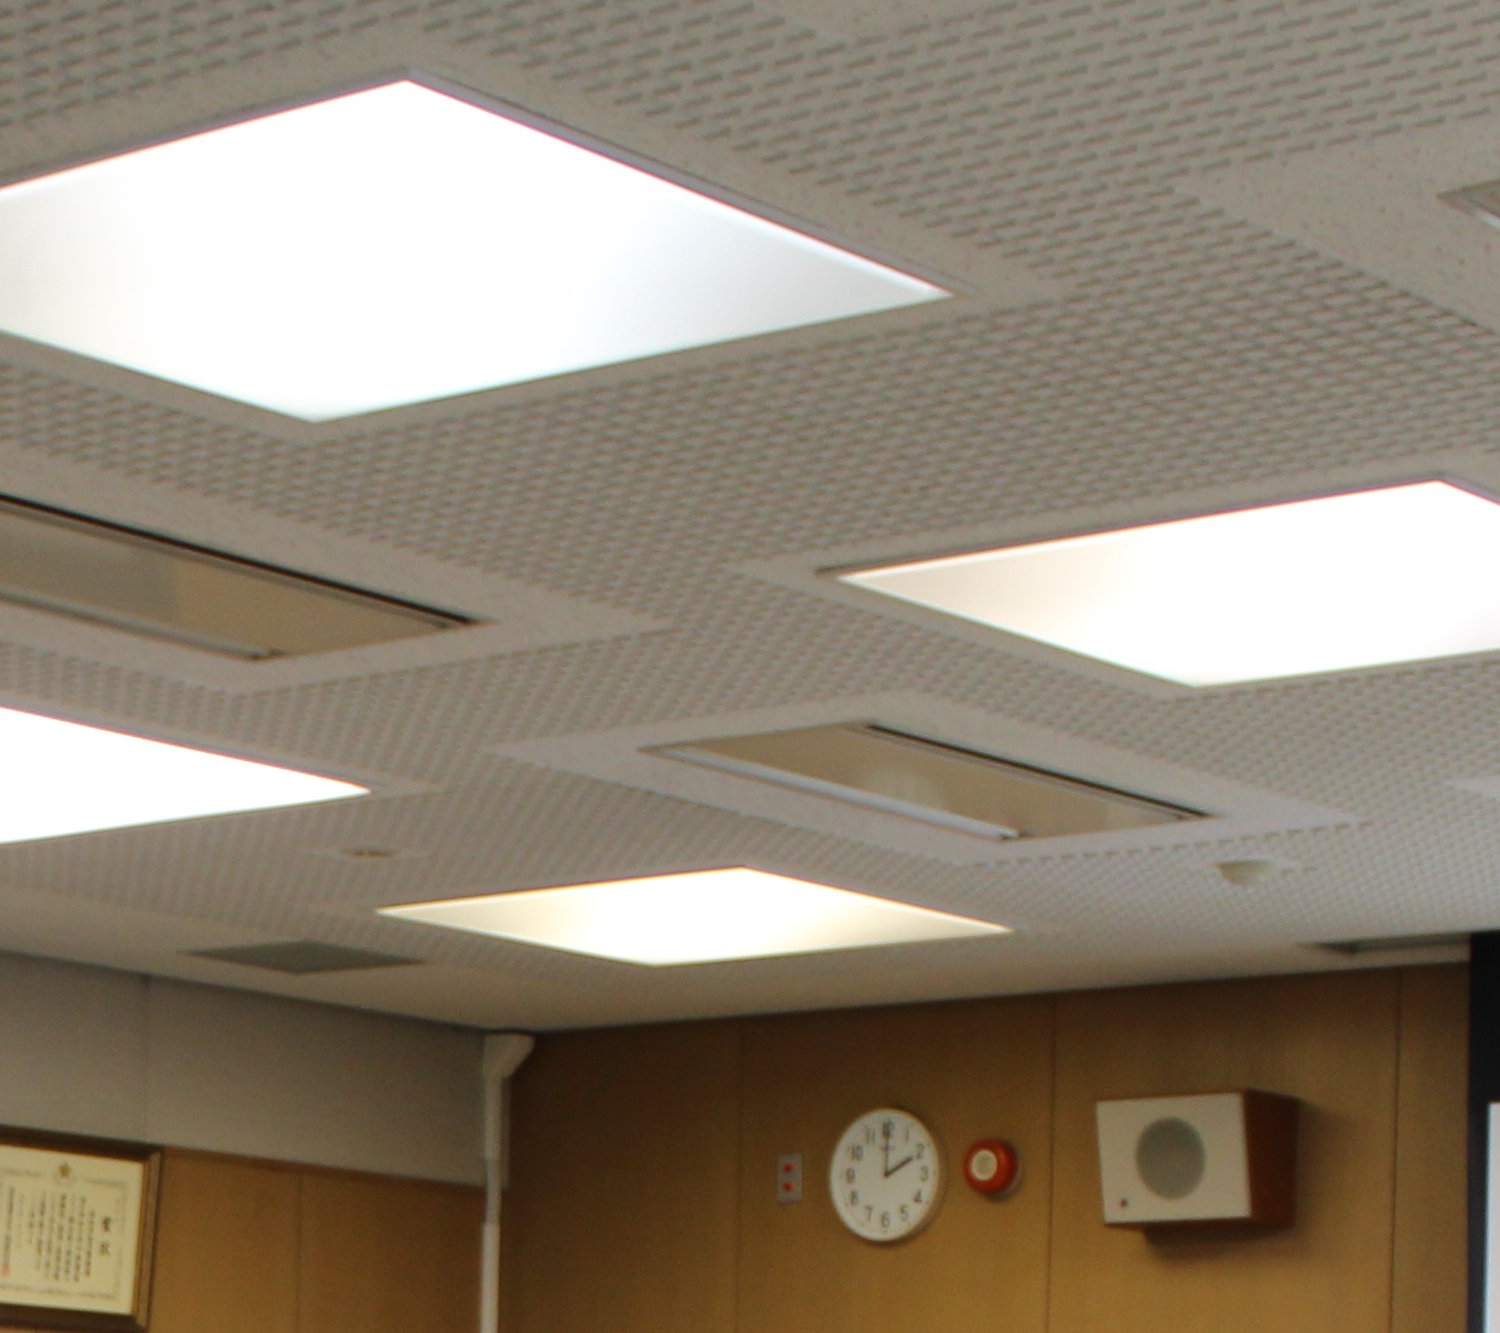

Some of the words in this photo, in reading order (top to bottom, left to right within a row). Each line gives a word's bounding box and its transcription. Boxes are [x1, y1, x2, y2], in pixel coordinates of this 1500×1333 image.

[850, 1144, 864, 1161] 10
[915, 1142, 925, 1160] 2
[845, 1167, 856, 1184] 9
[920, 1165, 929, 1182] 3
[850, 1190, 858, 1206] 8
[913, 1189, 922, 1204] 4
[864, 1205, 873, 1222] 7
[881, 1211, 890, 1228] 6
[900, 1203, 909, 1220] 5
